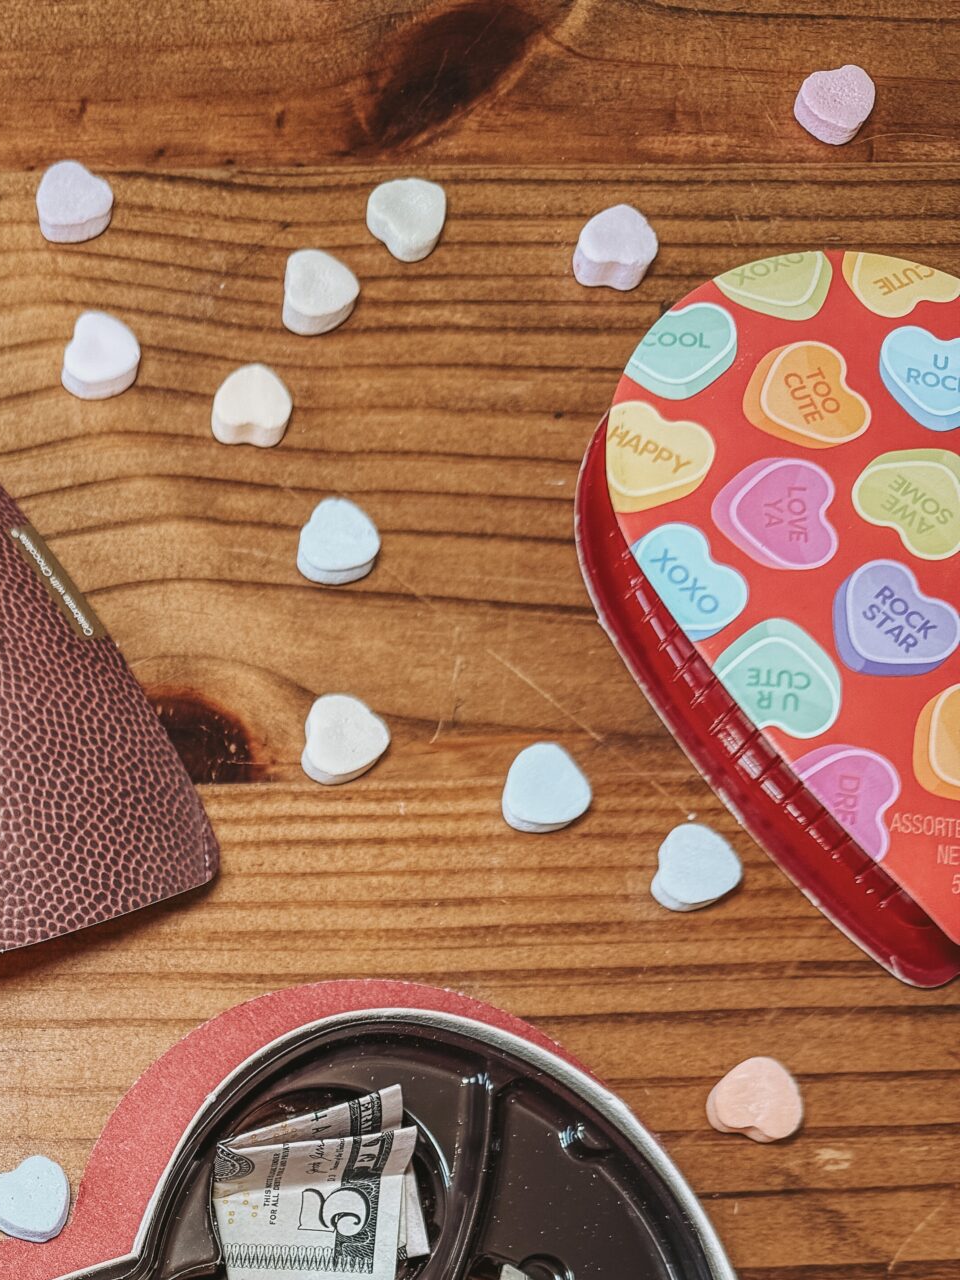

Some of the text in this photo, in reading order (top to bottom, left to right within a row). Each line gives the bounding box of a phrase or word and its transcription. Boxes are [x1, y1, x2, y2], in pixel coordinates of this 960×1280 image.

[873, 265, 935, 296] CUTIE
[932, 353, 949, 371] U
[783, 372, 824, 424] CUTE
[805, 367, 841, 414] TOO
[608, 425, 692, 476] HAPPY
[763, 499, 783, 528] YA
[786, 486, 809, 543] LOVE
[889, 473, 954, 525] SOME
[650, 548, 720, 616] XOXO
[861, 604, 919, 654] STAR
[872, 585, 938, 641] ROCK
[746, 667, 812, 690] CUTE
[756, 691, 800, 711] U R
